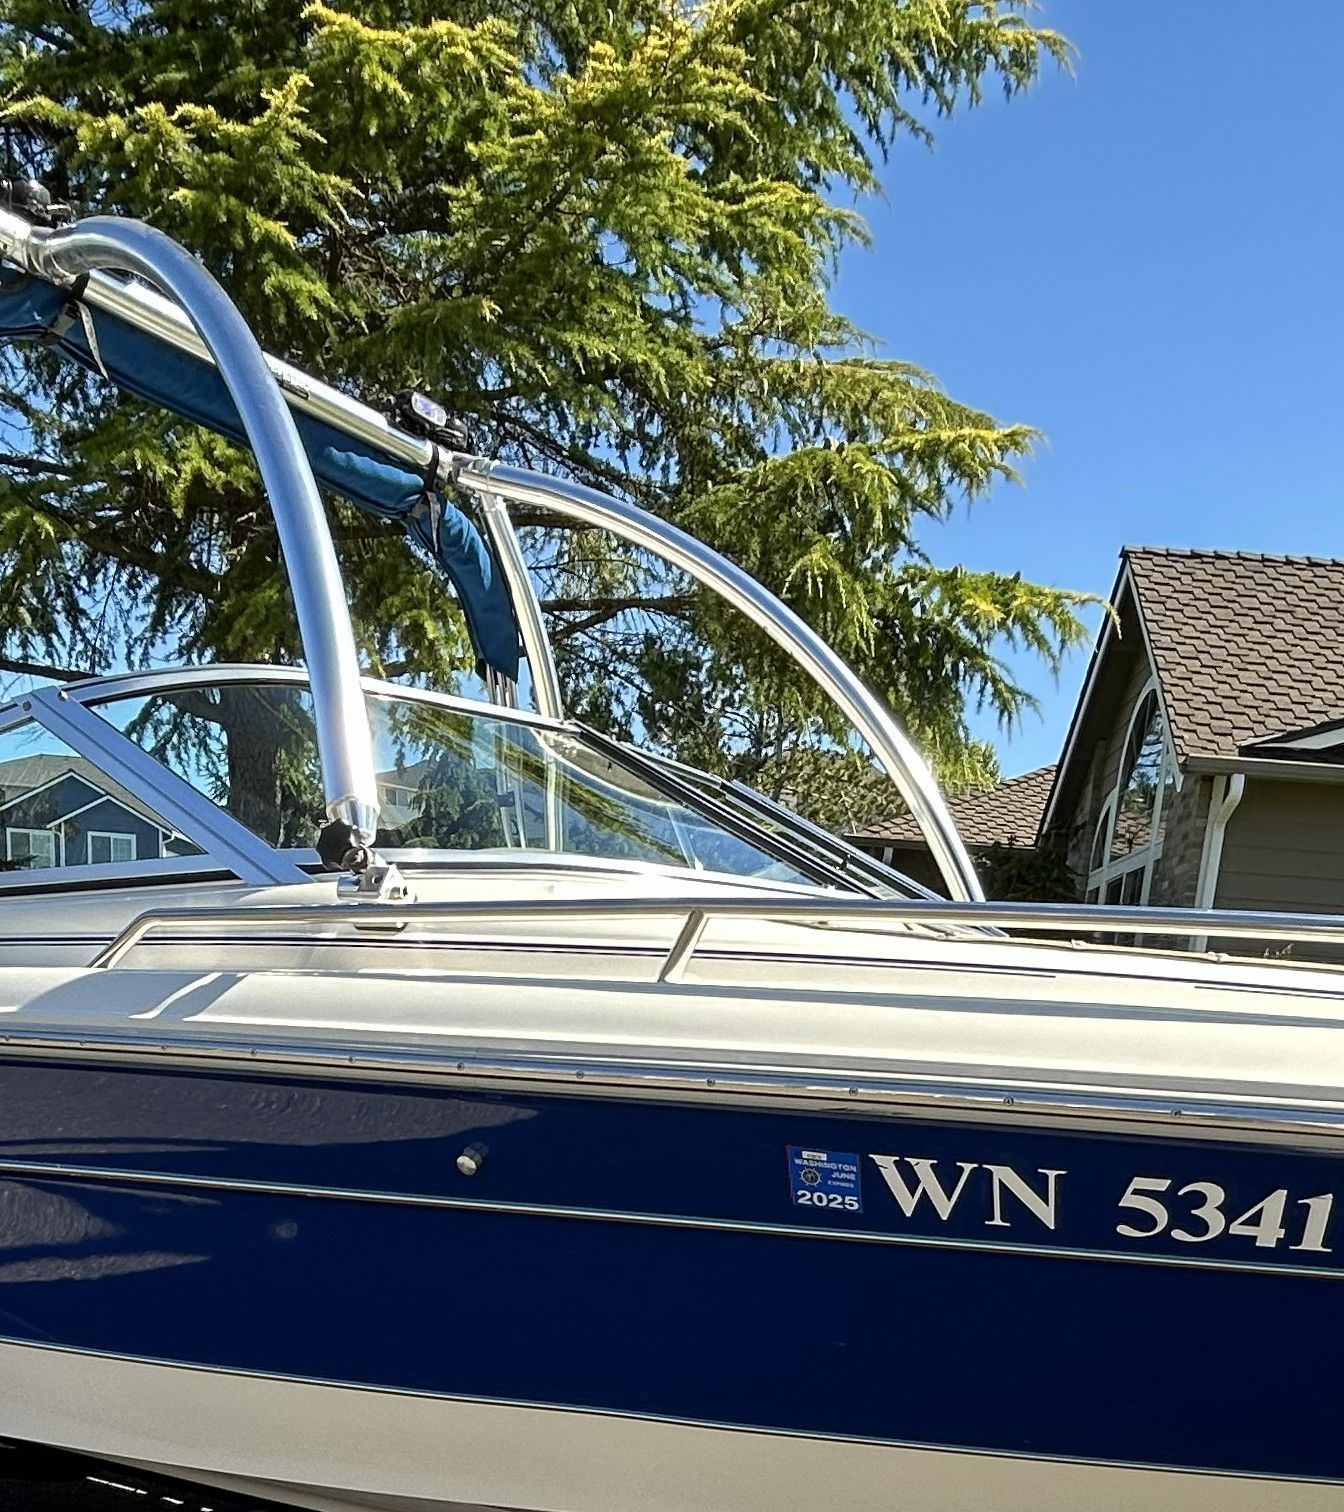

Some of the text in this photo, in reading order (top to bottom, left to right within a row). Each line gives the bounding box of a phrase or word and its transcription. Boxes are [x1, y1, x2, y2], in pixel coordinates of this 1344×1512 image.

[794, 1158, 857, 1172] WASHINGTON
[831, 1171, 856, 1181] JUNE
[796, 1189, 859, 1211] 2025
[868, 1154, 1067, 1230] WN
[1116, 1177, 1334, 1252] 5341
